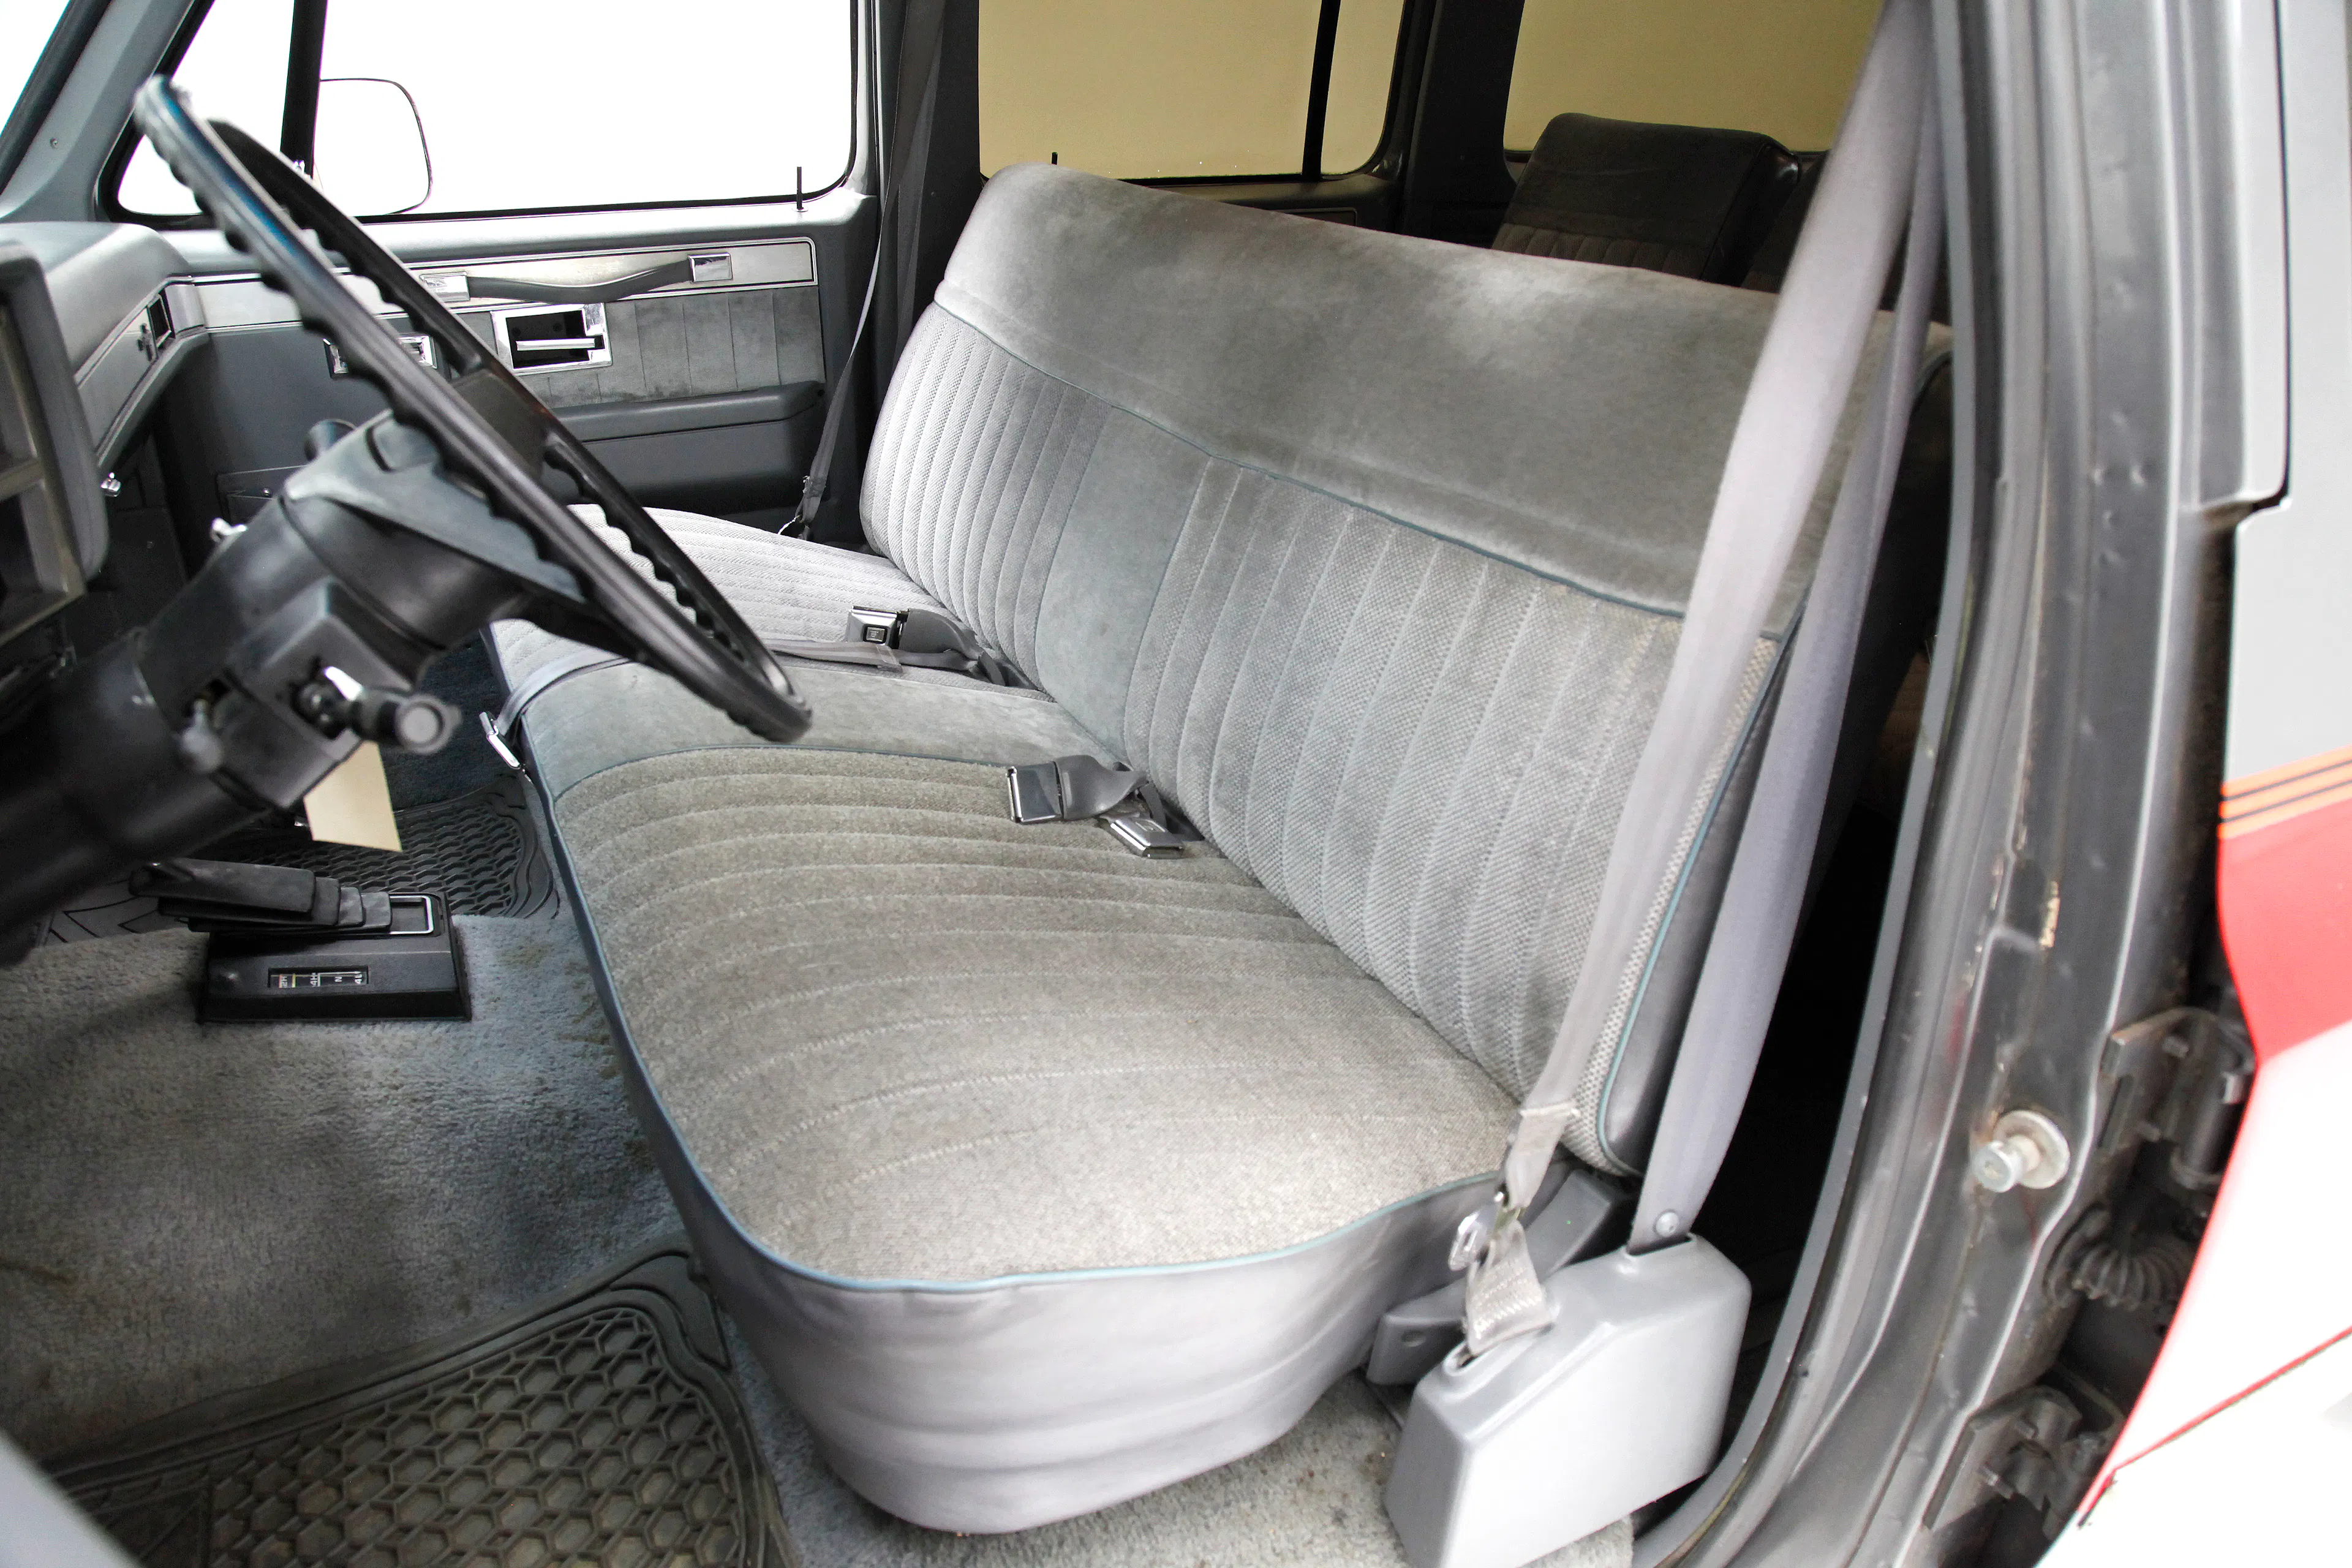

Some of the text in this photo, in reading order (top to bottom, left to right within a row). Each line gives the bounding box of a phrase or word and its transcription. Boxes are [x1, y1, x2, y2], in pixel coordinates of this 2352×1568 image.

[282, 976, 288, 987] 2H
[310, 974, 318, 986] 4H
[355, 974, 362, 984] 4L
